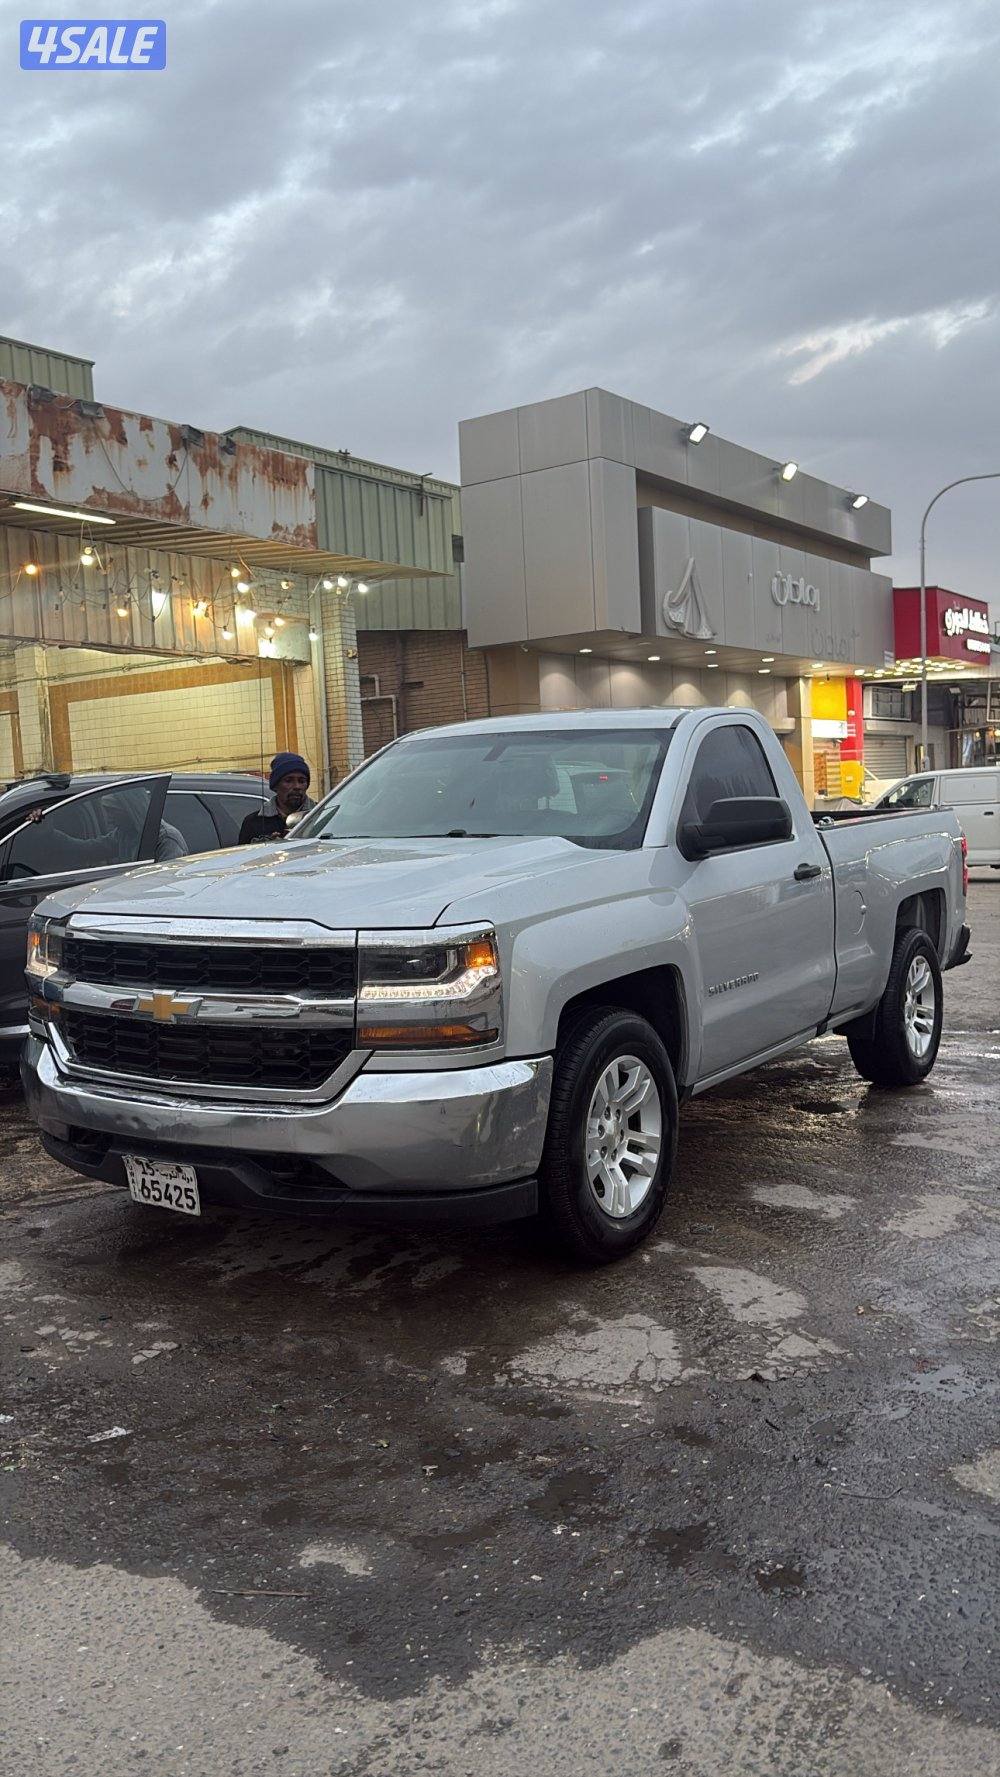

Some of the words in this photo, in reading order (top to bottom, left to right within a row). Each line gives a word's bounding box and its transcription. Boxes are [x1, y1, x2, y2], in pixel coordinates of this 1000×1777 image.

[708, 972, 759, 997] SILVERADO
[140, 1160, 155, 1176] 15
[141, 1178, 196, 1210] 65425
